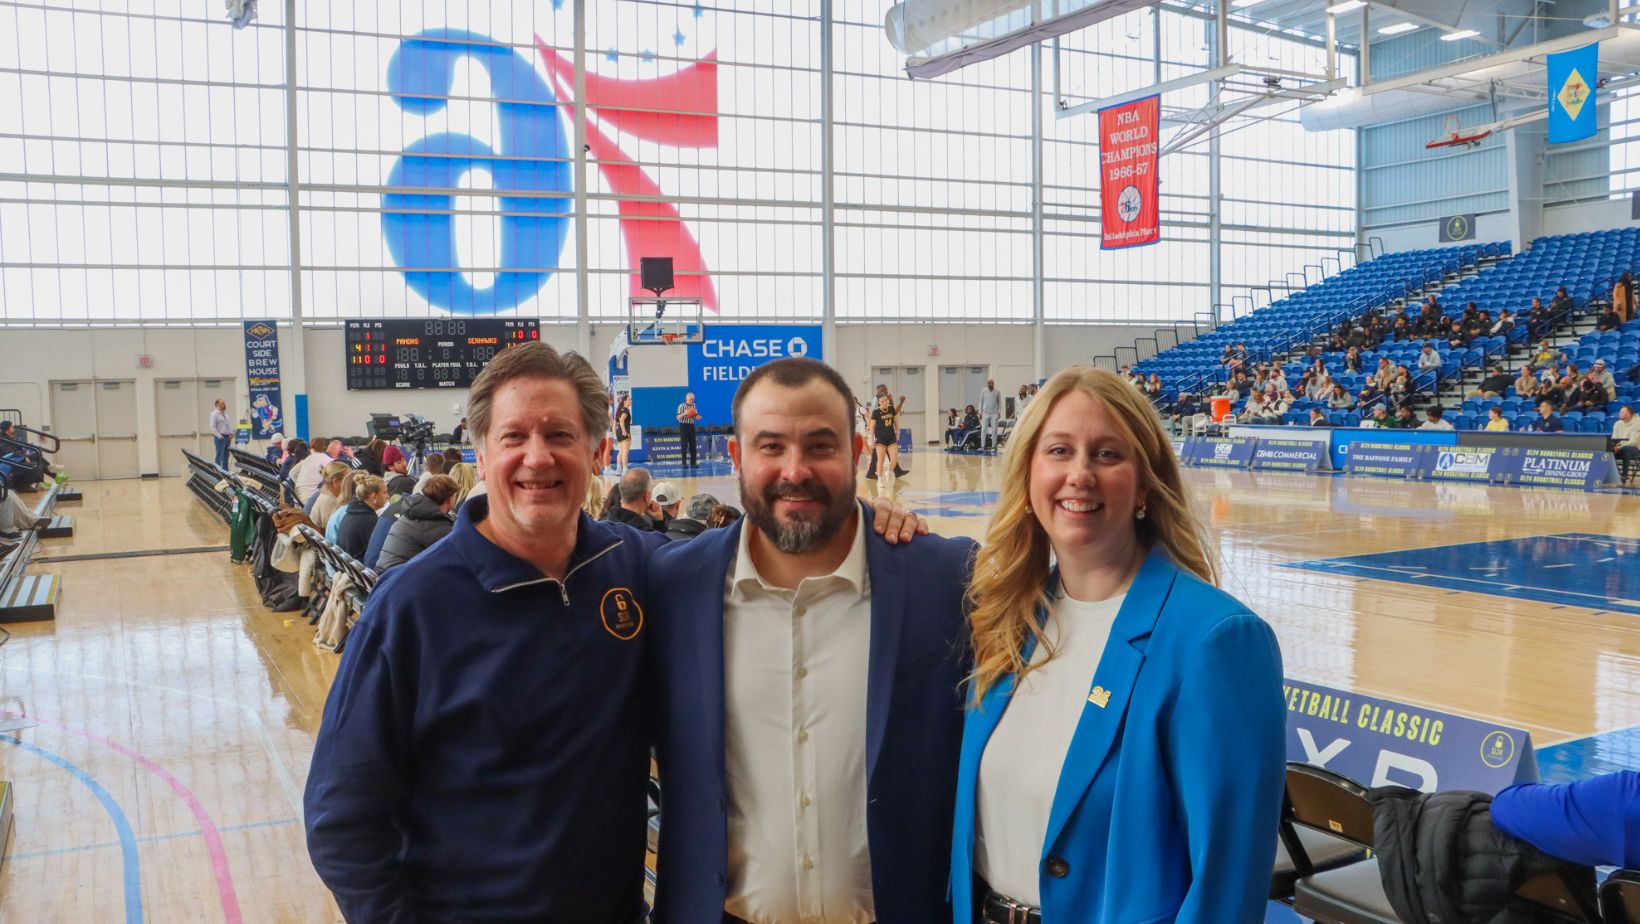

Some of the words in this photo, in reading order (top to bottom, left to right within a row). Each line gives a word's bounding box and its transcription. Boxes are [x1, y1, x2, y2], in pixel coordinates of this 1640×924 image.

[1117, 110, 1140, 126] NBA
[1110, 126, 1148, 145] WORLD
[1101, 142, 1157, 165] CHAMPIONS
[1110, 162, 1148, 181] 1966-67
[246, 340, 277, 349] COURT
[702, 339, 783, 358] CHASE
[252, 350, 272, 358] SIDE
[248, 358, 278, 367] BREW
[248, 368, 278, 376] HOUSE
[1274, 450, 1318, 460] COMMERCIAL
[1454, 454, 1489, 466] CBM
[1522, 457, 1592, 472] PLATINUM
[1357, 704, 1444, 746] CLASSIC
